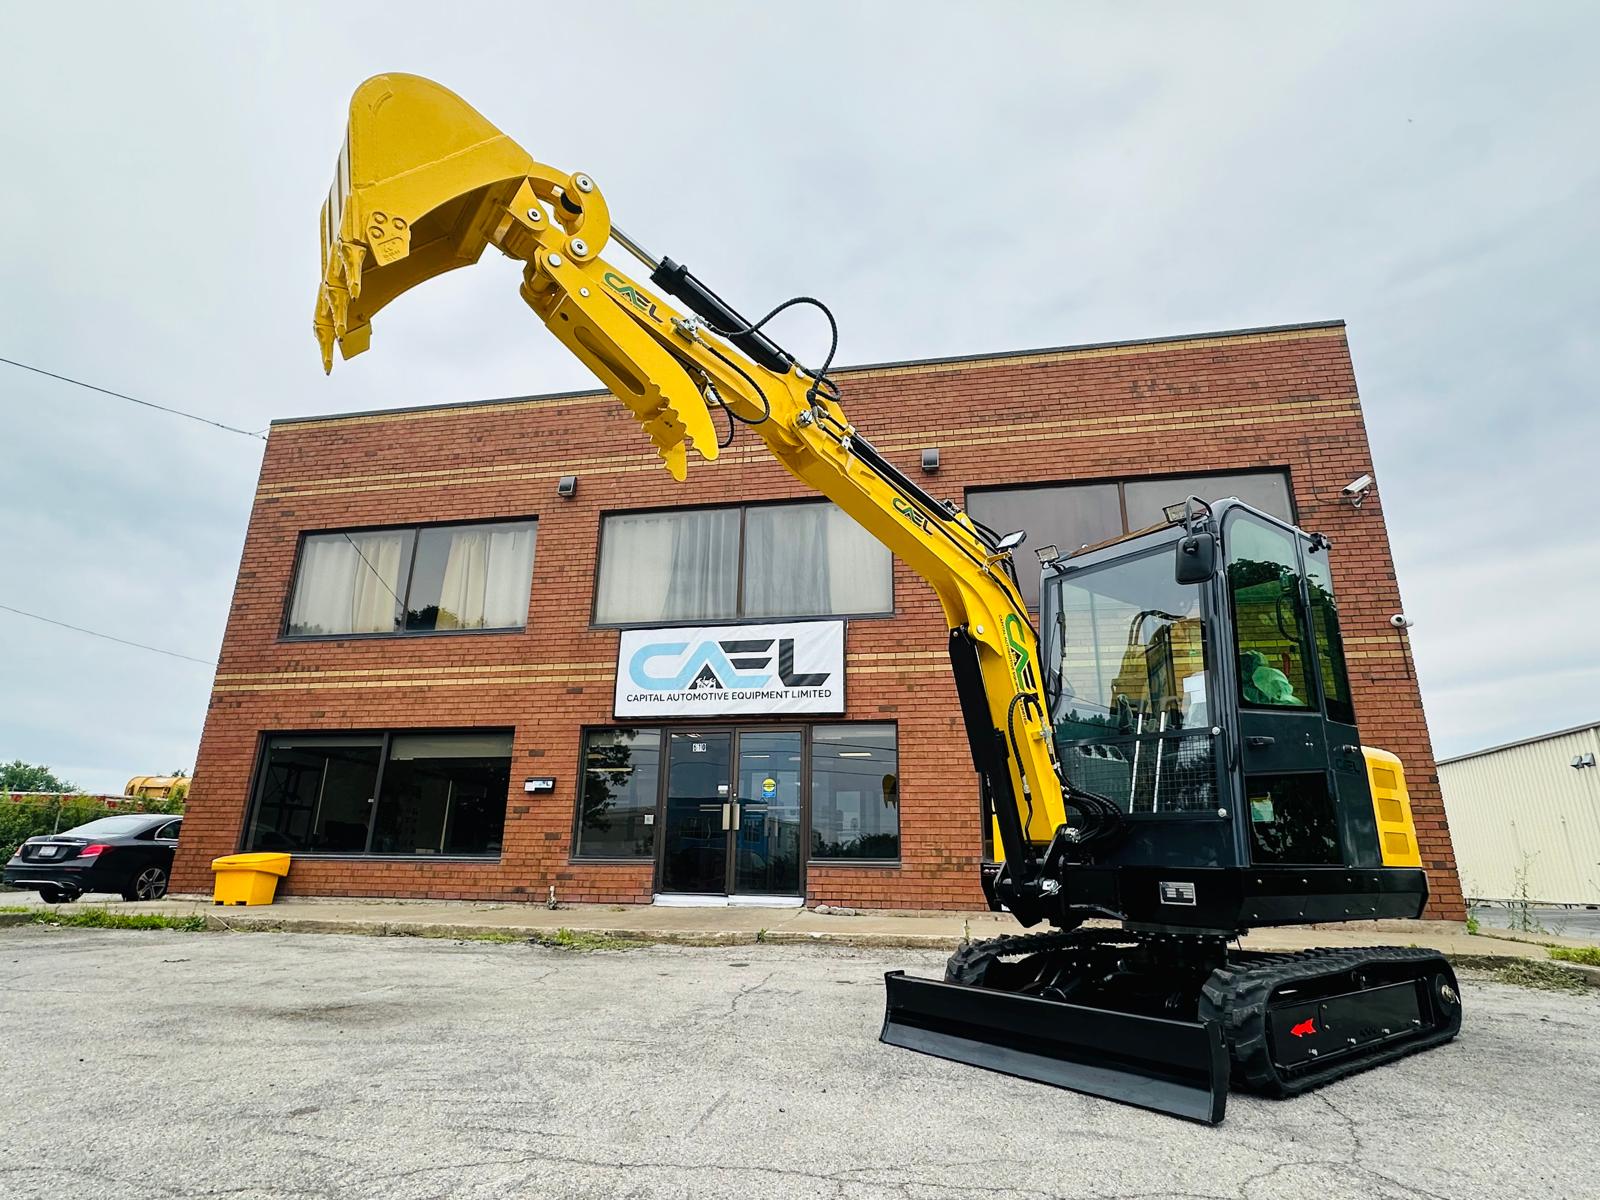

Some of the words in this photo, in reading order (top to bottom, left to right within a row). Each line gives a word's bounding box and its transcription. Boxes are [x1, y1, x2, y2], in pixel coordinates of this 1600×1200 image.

[604, 272, 663, 323] CAEL
[893, 497, 933, 535] CAEL
[628, 638, 831, 691] CAEL
[626, 694, 665, 702] CAPITAL
[666, 692, 729, 701] AUTOMOTIVE
[731, 691, 790, 700] EQUIPMENT
[791, 689, 832, 698] LIMITED
